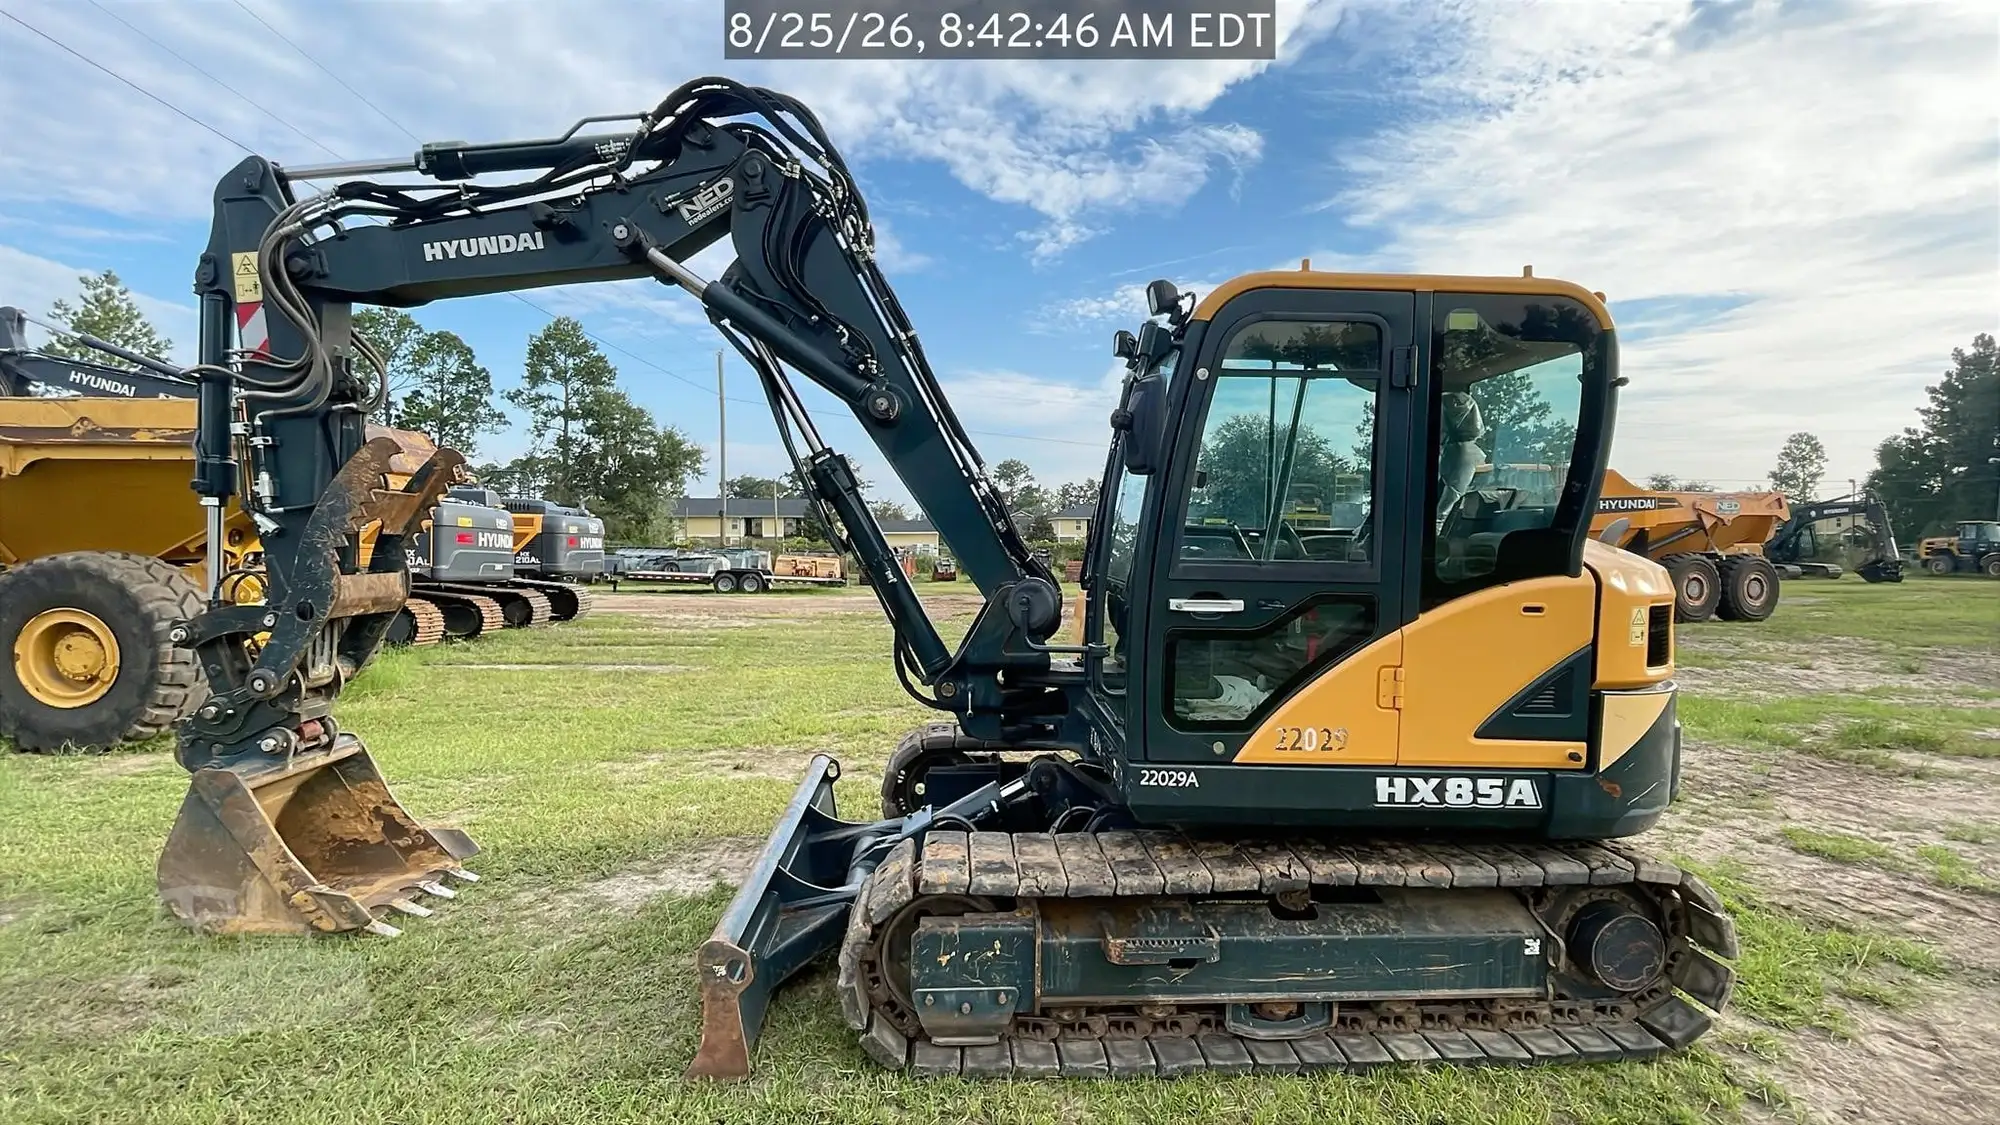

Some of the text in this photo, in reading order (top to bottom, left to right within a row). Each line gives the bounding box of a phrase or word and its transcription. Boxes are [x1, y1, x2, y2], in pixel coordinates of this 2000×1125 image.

[678, 177, 734, 221] NED
[423, 231, 545, 262] HYUNDAI
[69, 370, 137, 397] HYUNDAI
[1599, 499, 1655, 510] HYUNDAI
[1139, 769, 1200, 788] 22029A
[1374, 776, 1542, 809] HX85A
